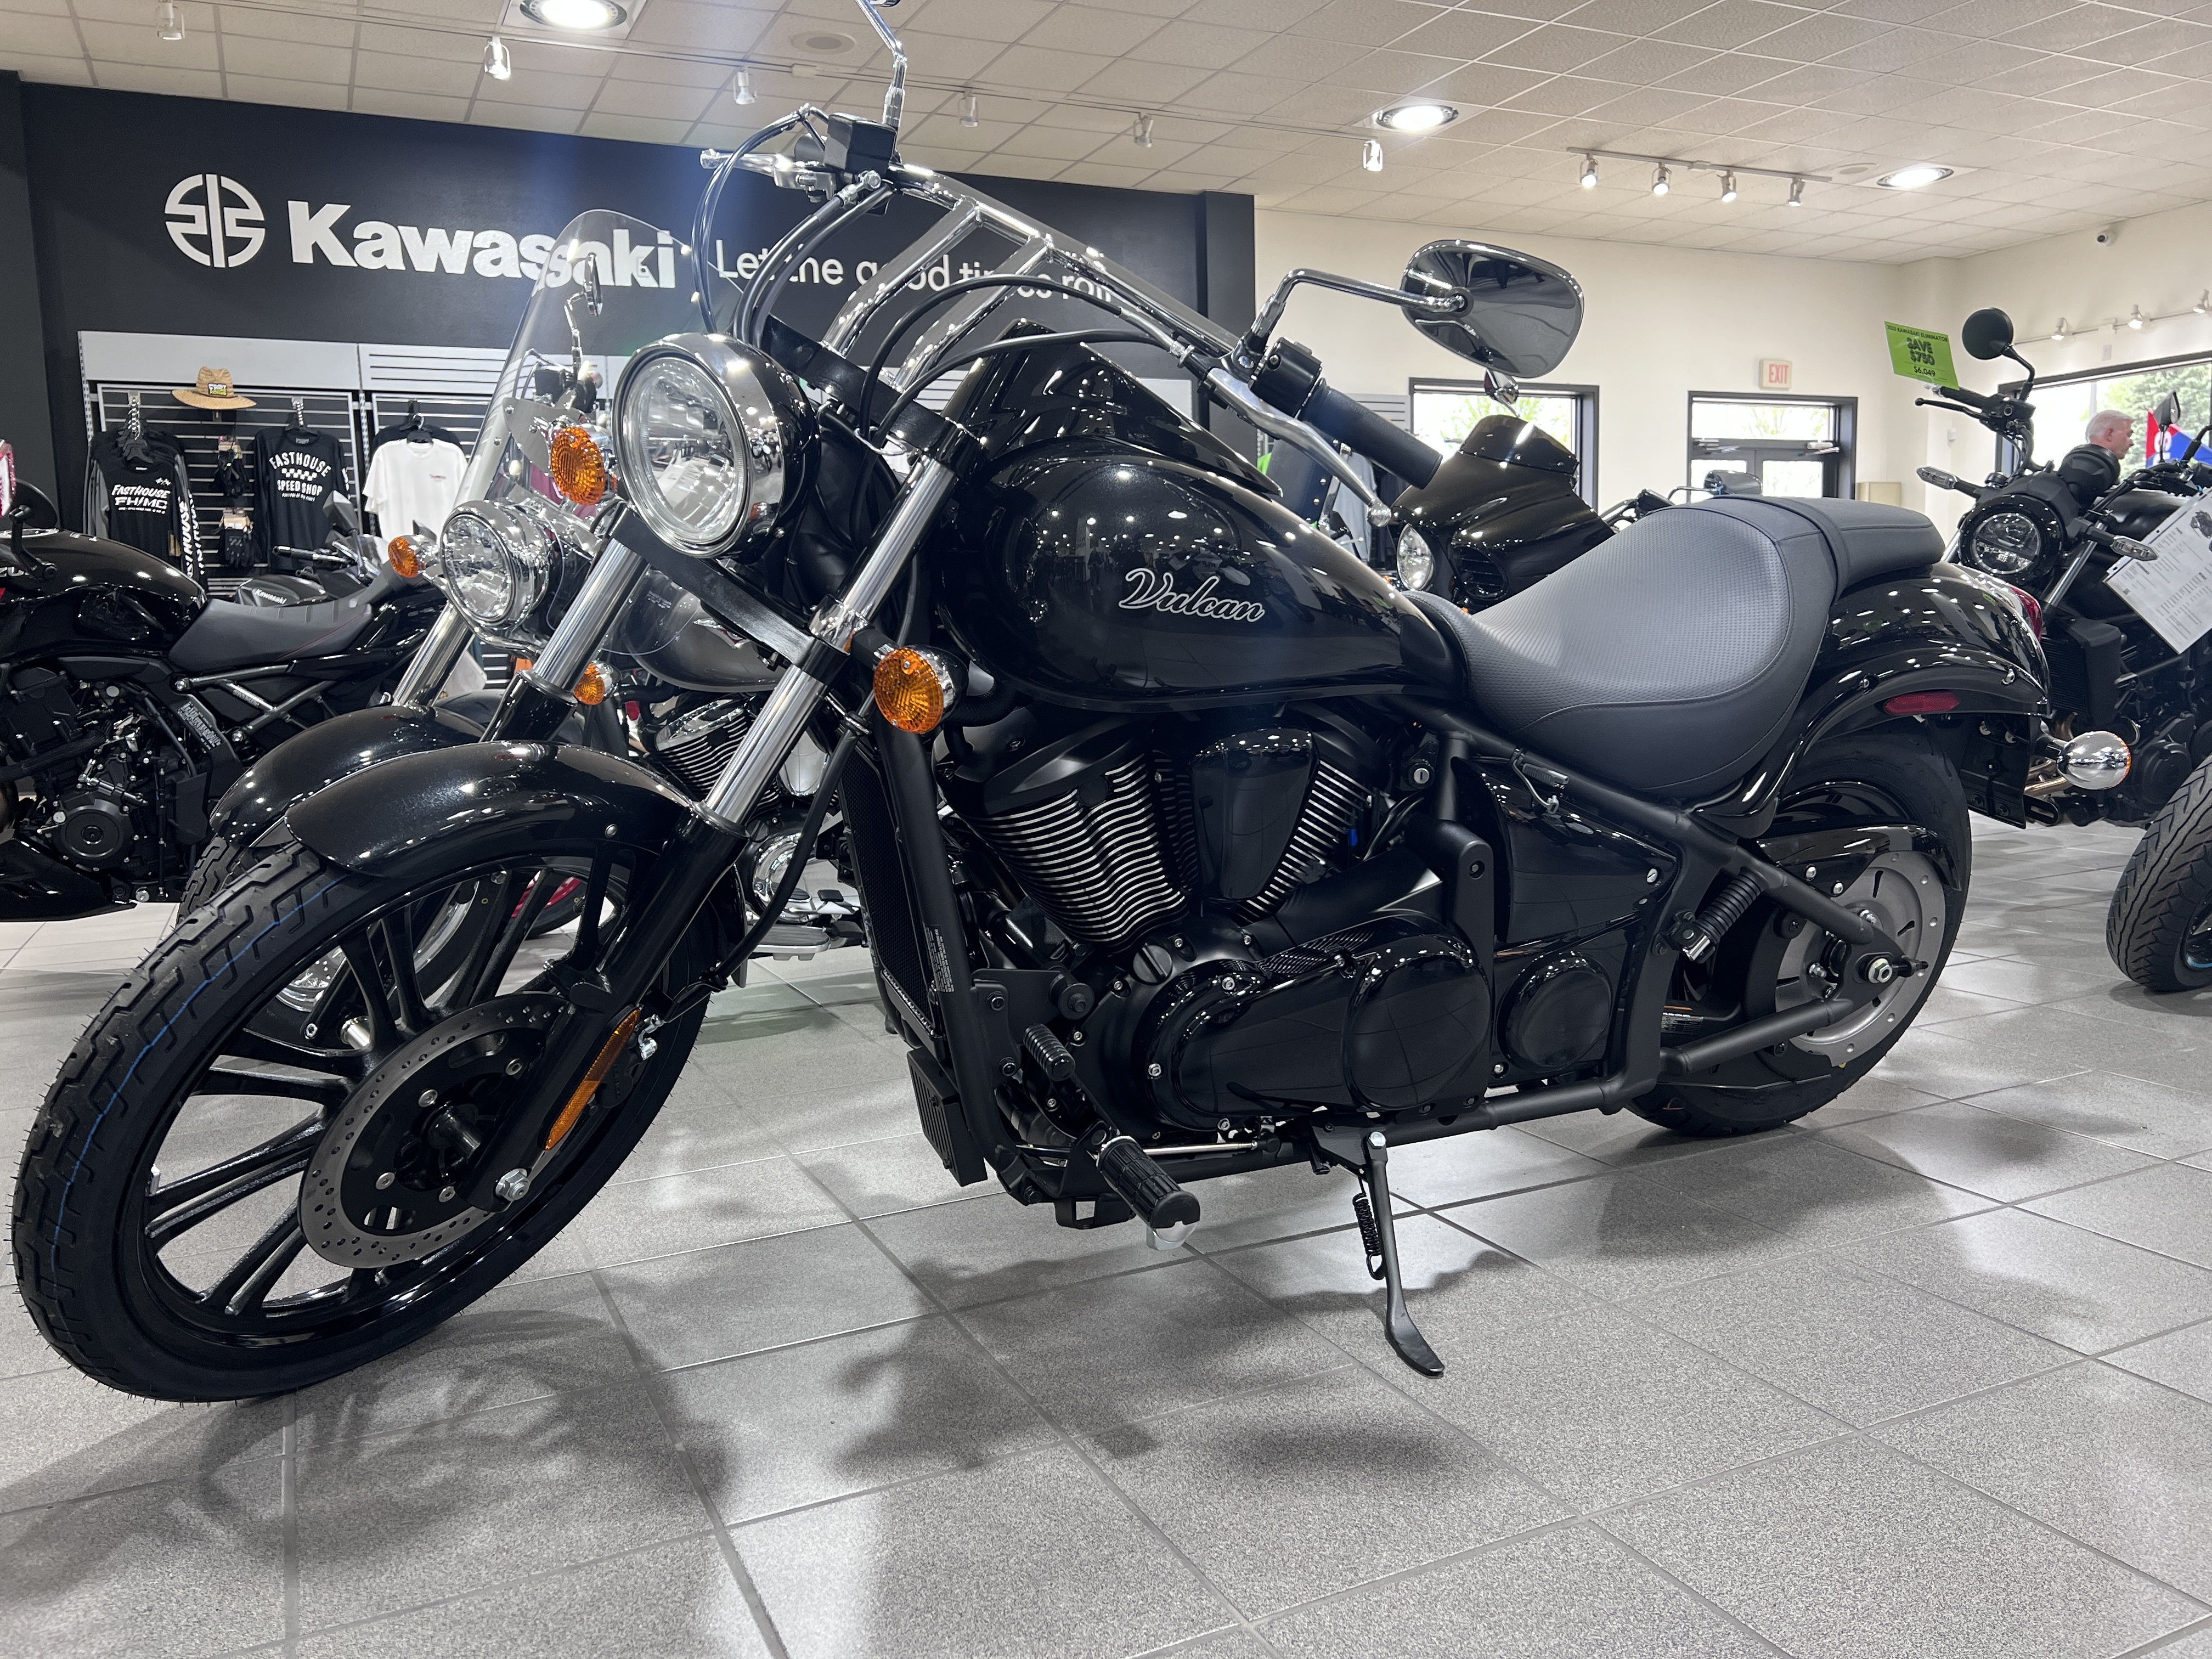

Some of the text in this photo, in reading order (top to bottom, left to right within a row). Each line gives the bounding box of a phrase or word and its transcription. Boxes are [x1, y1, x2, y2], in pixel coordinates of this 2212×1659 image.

[287, 200, 675, 289] Kawasaki
[856, 253, 950, 292] god
[1898, 327, 1920, 336] KAWASAKI
[1920, 331, 1948, 342] ELIMINATOR
[1906, 337, 1933, 354] SAVE
[1909, 349, 1935, 365] $750
[1769, 363, 1789, 384] EXIT
[1914, 366, 1936, 377] $6,049
[268, 452, 332, 478] FASTHOUSE
[111, 484, 171, 499] FASTHOUSE
[277, 480, 323, 496] SPEED SHOP
[115, 496, 168, 510] FH/MC
[255, 589, 287, 605] Kawasaki
[1119, 568, 1265, 622] Vulcan
